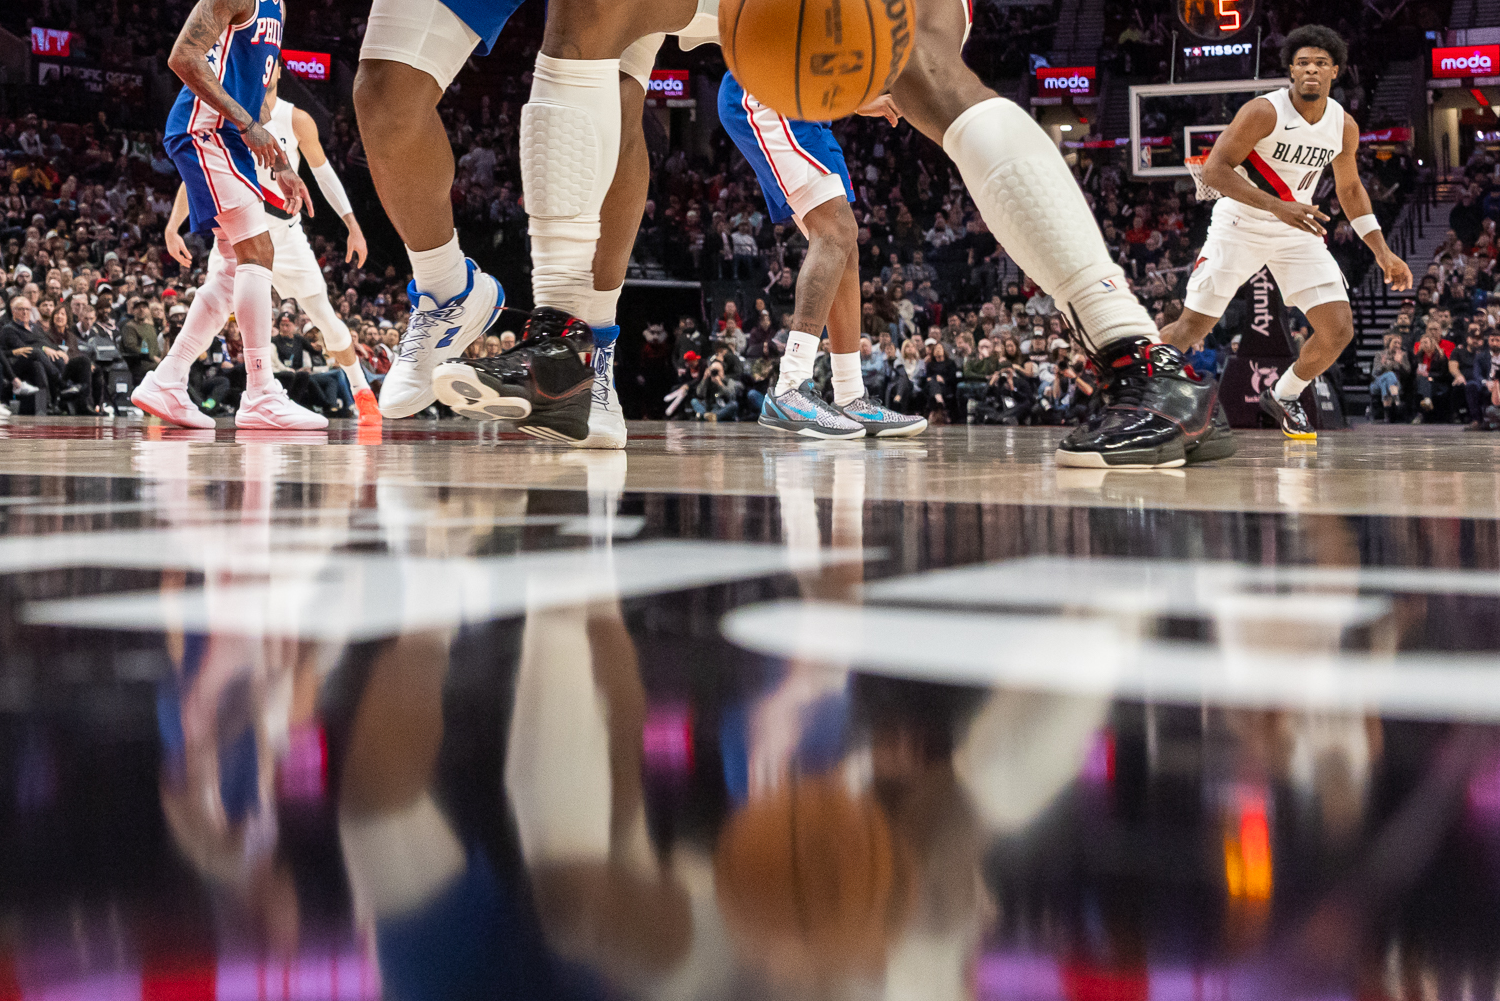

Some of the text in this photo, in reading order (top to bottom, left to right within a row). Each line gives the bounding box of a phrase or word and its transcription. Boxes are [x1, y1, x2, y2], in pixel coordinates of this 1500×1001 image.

[1202, 43, 1252, 57] TISSOT
[262, 54, 274, 88] 9
[287, 59, 325, 75] moda
[1441, 53, 1492, 70] moda
[1044, 73, 1089, 89] moda
[1272, 141, 1334, 168] BLAZERS
[1297, 170, 1318, 191] 00
[1250, 268, 1274, 337] xfinity
